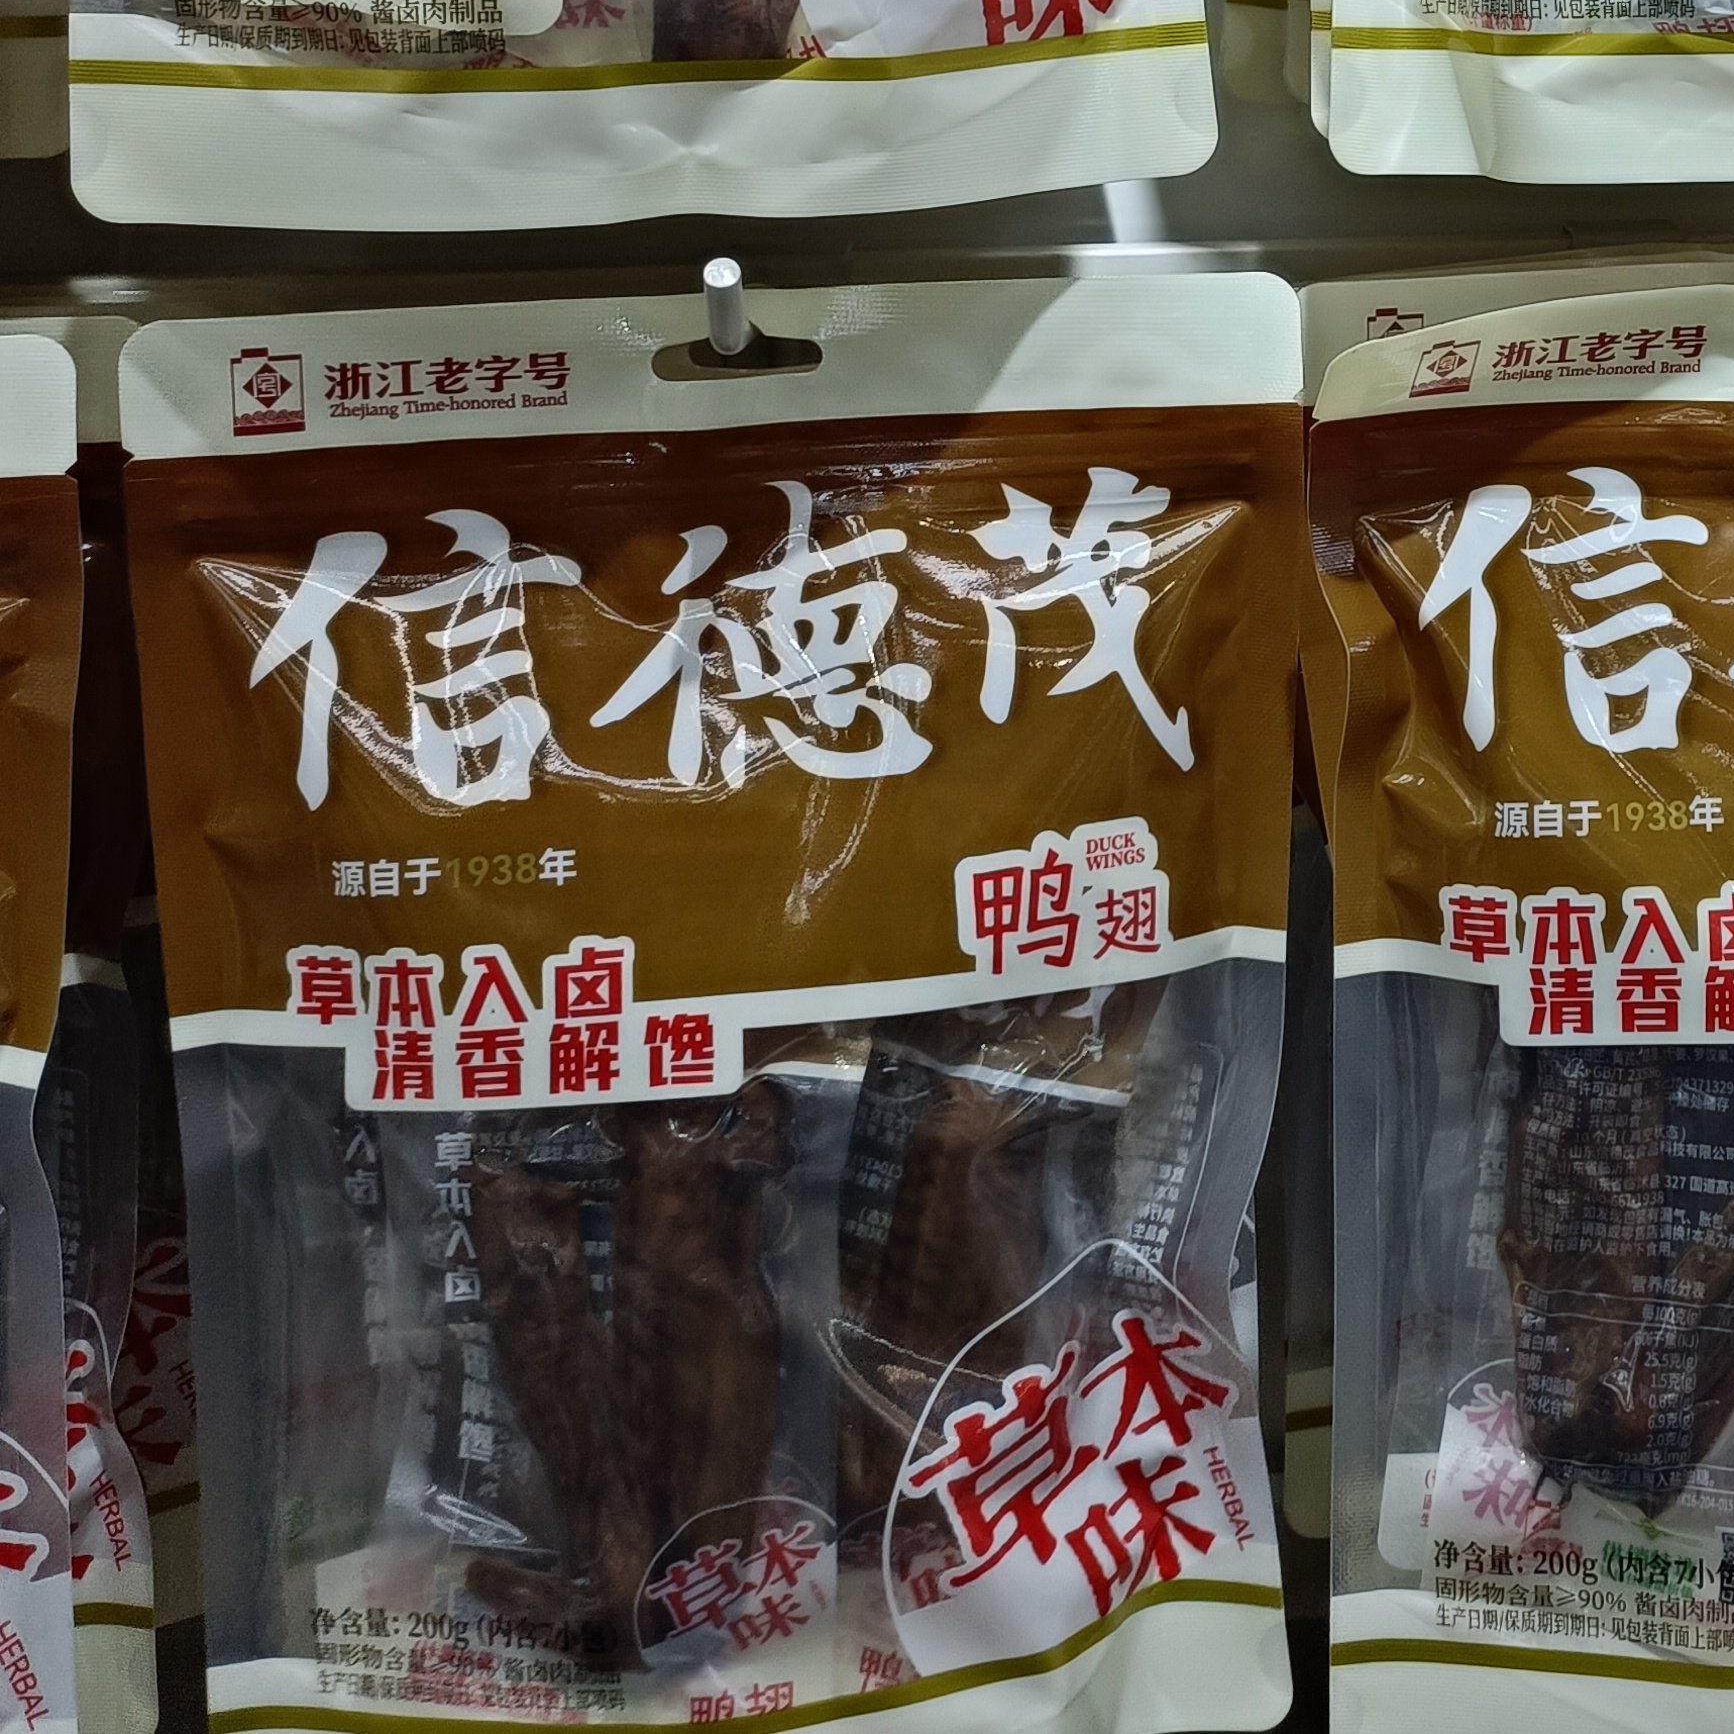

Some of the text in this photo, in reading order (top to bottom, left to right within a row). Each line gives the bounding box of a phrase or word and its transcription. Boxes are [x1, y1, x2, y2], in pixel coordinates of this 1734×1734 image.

[1492, 326, 1707, 368] 浙江老字号
[1492, 359, 1701, 383] Zhejiang Time-honored Brand
[324, 351, 571, 402] 浙江老字号
[330, 390, 568, 420] Zhejiang Time-honored Brand
[250, 467, 1194, 811] 信德茂
[1494, 795, 1724, 839] 源自于1938年
[1086, 832, 1136, 855] DUCK
[1086, 848, 1145, 871] WINGS
[332, 847, 577, 899] 源自于1938年
[972, 849, 1161, 974] 鸭翅
[296, 947, 625, 1025] 草本入卤
[372, 1014, 714, 1101] 清香解馋
[909, 1318, 1230, 1616] 草本味
[90, 1471, 131, 1571] HERBAL
[1203, 1446, 1254, 1551] HERBAL
[1436, 1577, 1627, 1614] 固形物含量≥90%
